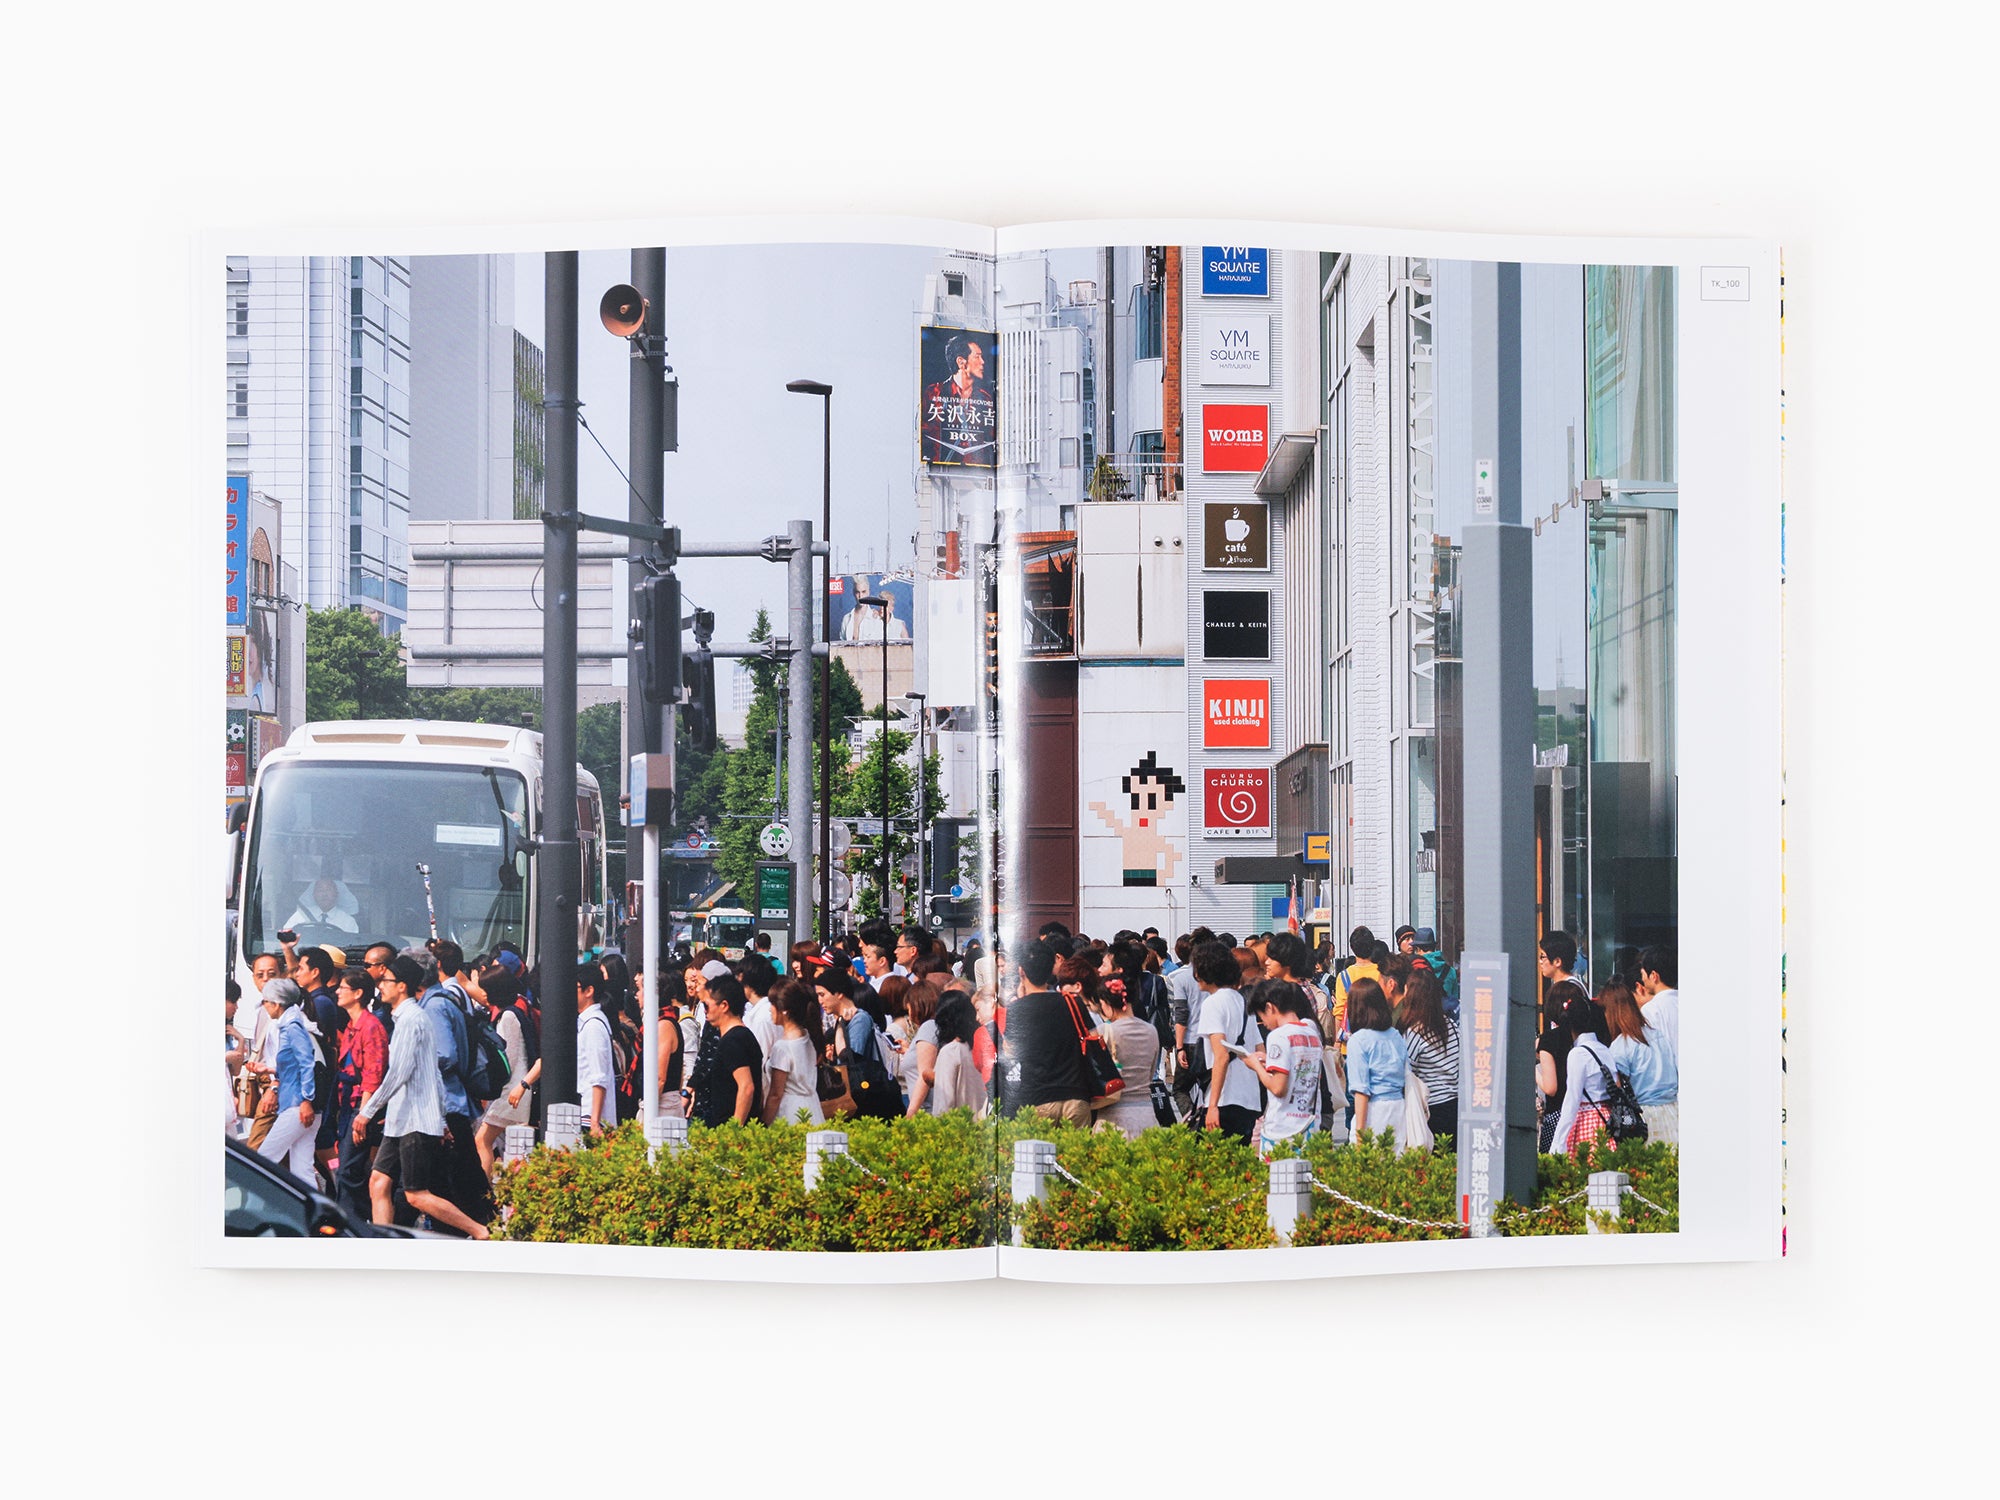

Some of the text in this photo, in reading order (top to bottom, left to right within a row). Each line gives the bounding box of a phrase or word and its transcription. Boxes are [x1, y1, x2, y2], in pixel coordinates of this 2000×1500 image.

[1220, 245, 1250, 260] YM
[1209, 261, 1261, 274] SQUARE
[1711, 280, 1740, 289] TK_100
[1219, 329, 1250, 347] YM
[1209, 349, 1261, 361] SQUARE
[927, 402, 996, 427] 矢沢永吉
[949, 431, 978, 442] BOX
[1224, 542, 1248, 553] café
[1209, 698, 1265, 719] KINJI
[1213, 717, 1261, 727] used clothing
[1210, 779, 1264, 787] CHURRO
[1472, 975, 1493, 1108] 二輪車事故多発
